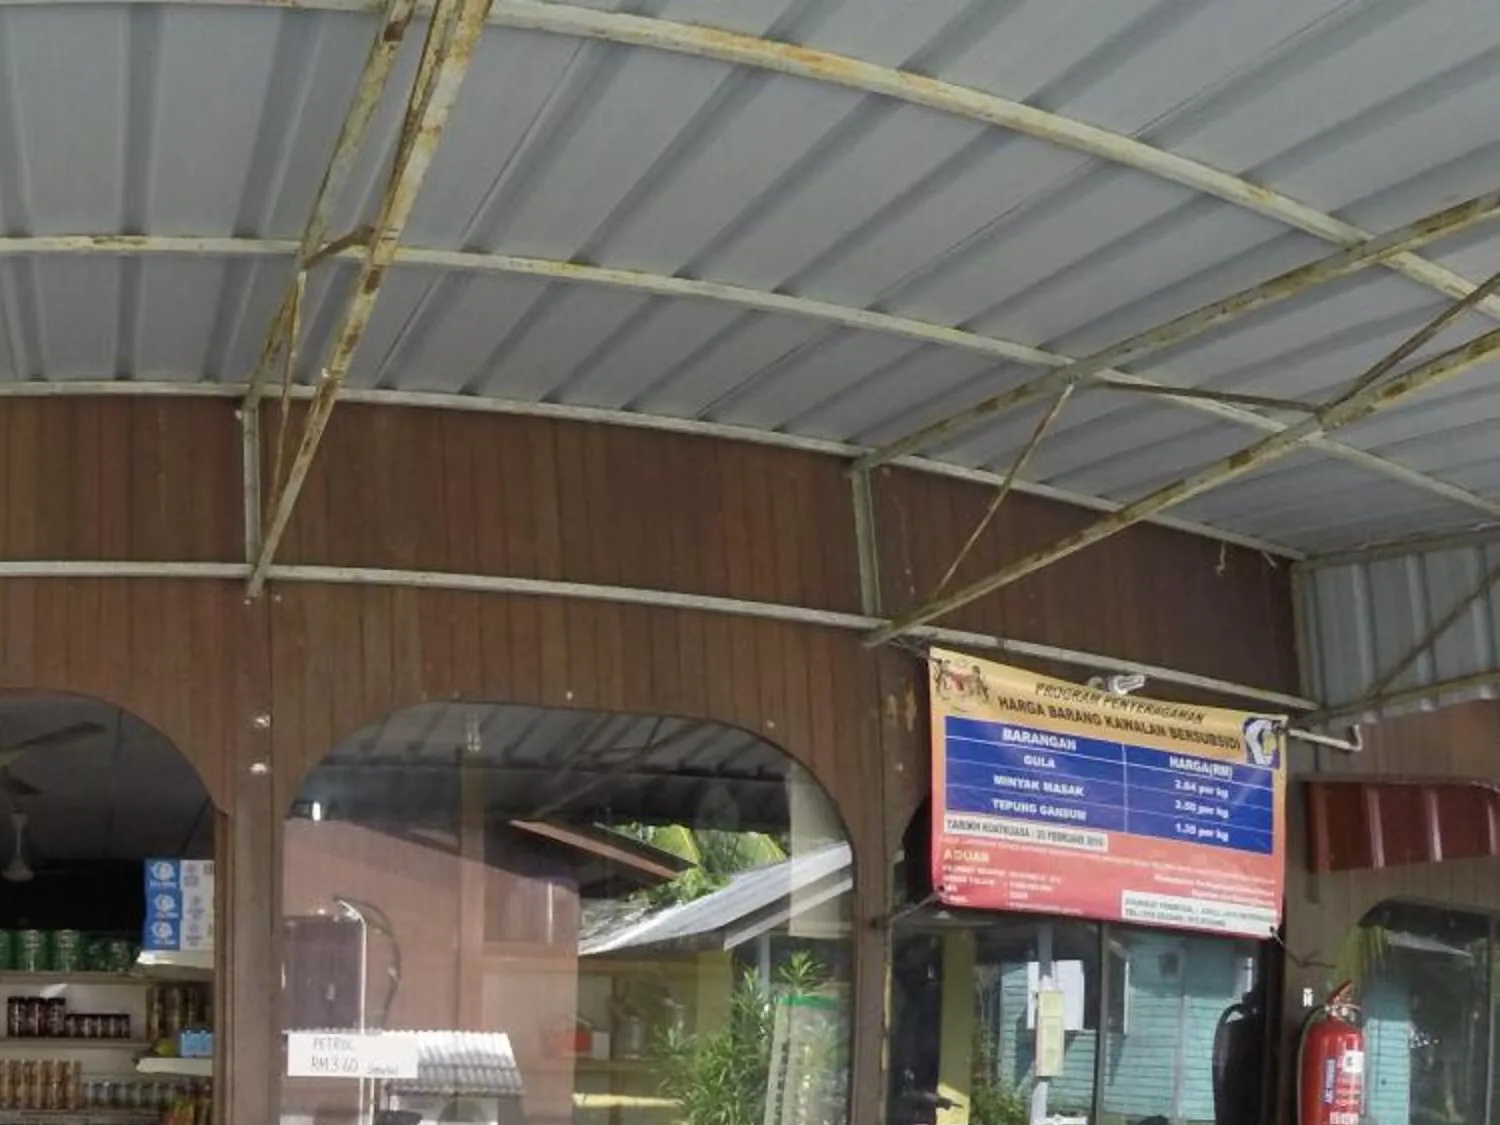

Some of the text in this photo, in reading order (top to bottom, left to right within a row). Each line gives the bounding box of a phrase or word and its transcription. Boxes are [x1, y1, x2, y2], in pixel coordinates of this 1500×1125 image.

[998, 696, 1046, 717] HARGA
[1049, 705, 1102, 727] BARANG
[1104, 713, 1167, 737] KAWALAN
[1002, 727, 1078, 751] BARANGAN
[1023, 754, 1056, 769] GULA
[993, 774, 1085, 797] MINYAK MASAK
[992, 799, 1088, 821] TEPUNG GANDUM
[943, 849, 990, 864] ADUAN
[312, 1036, 356, 1052] PETROL
